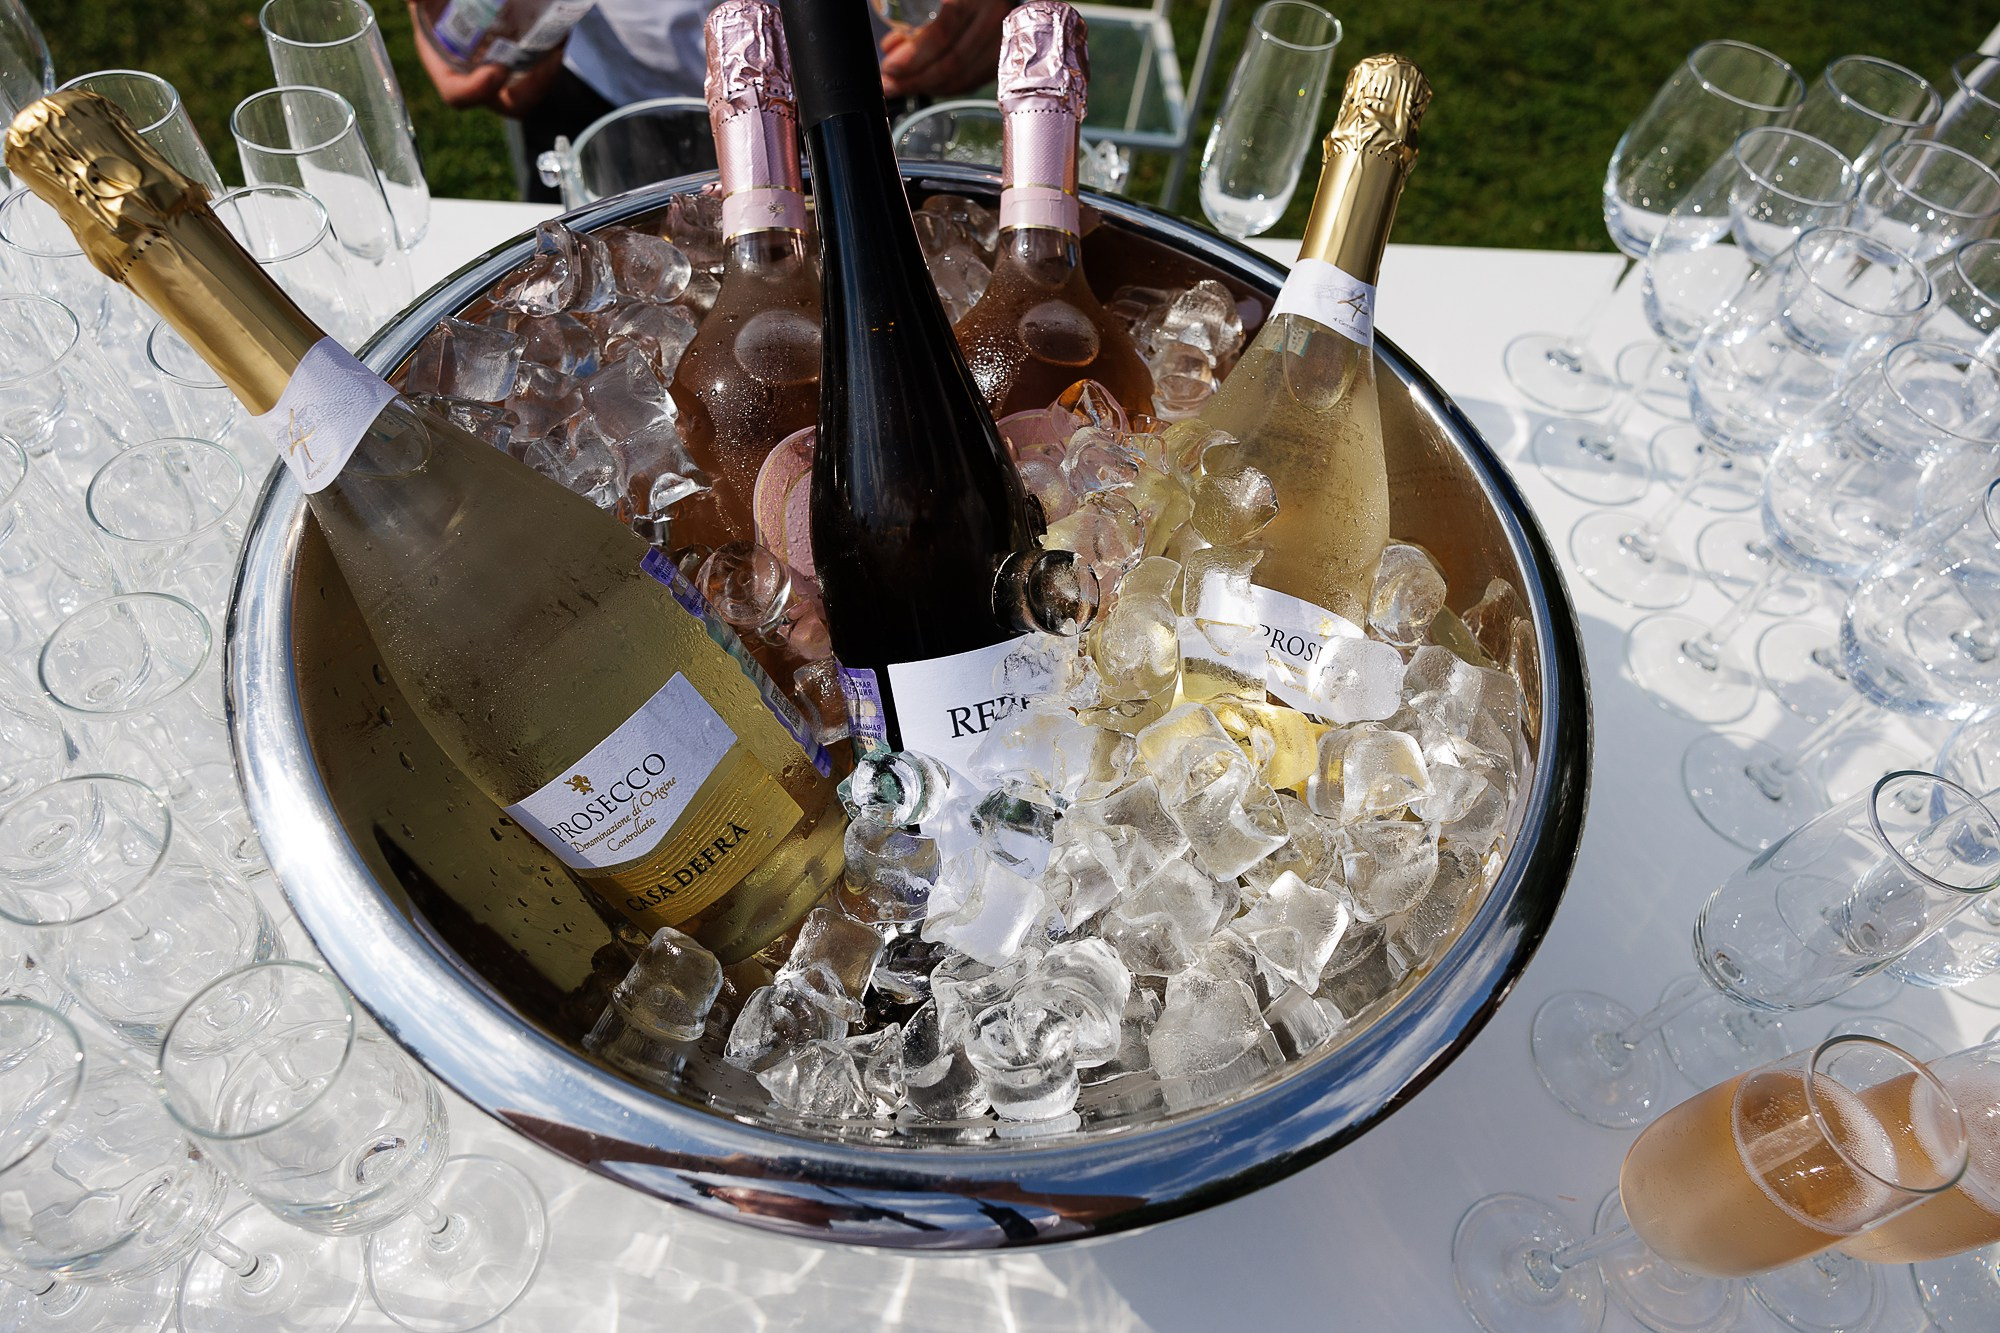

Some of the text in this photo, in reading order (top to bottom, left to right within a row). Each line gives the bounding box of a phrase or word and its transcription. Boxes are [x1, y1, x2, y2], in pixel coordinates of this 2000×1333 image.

[548, 753, 666, 844] PROSECCO
[571, 776, 677, 854] Denominazione di Origine
[606, 816, 657, 852] Controllata
[626, 821, 751, 912] CASA DEFRÀ
